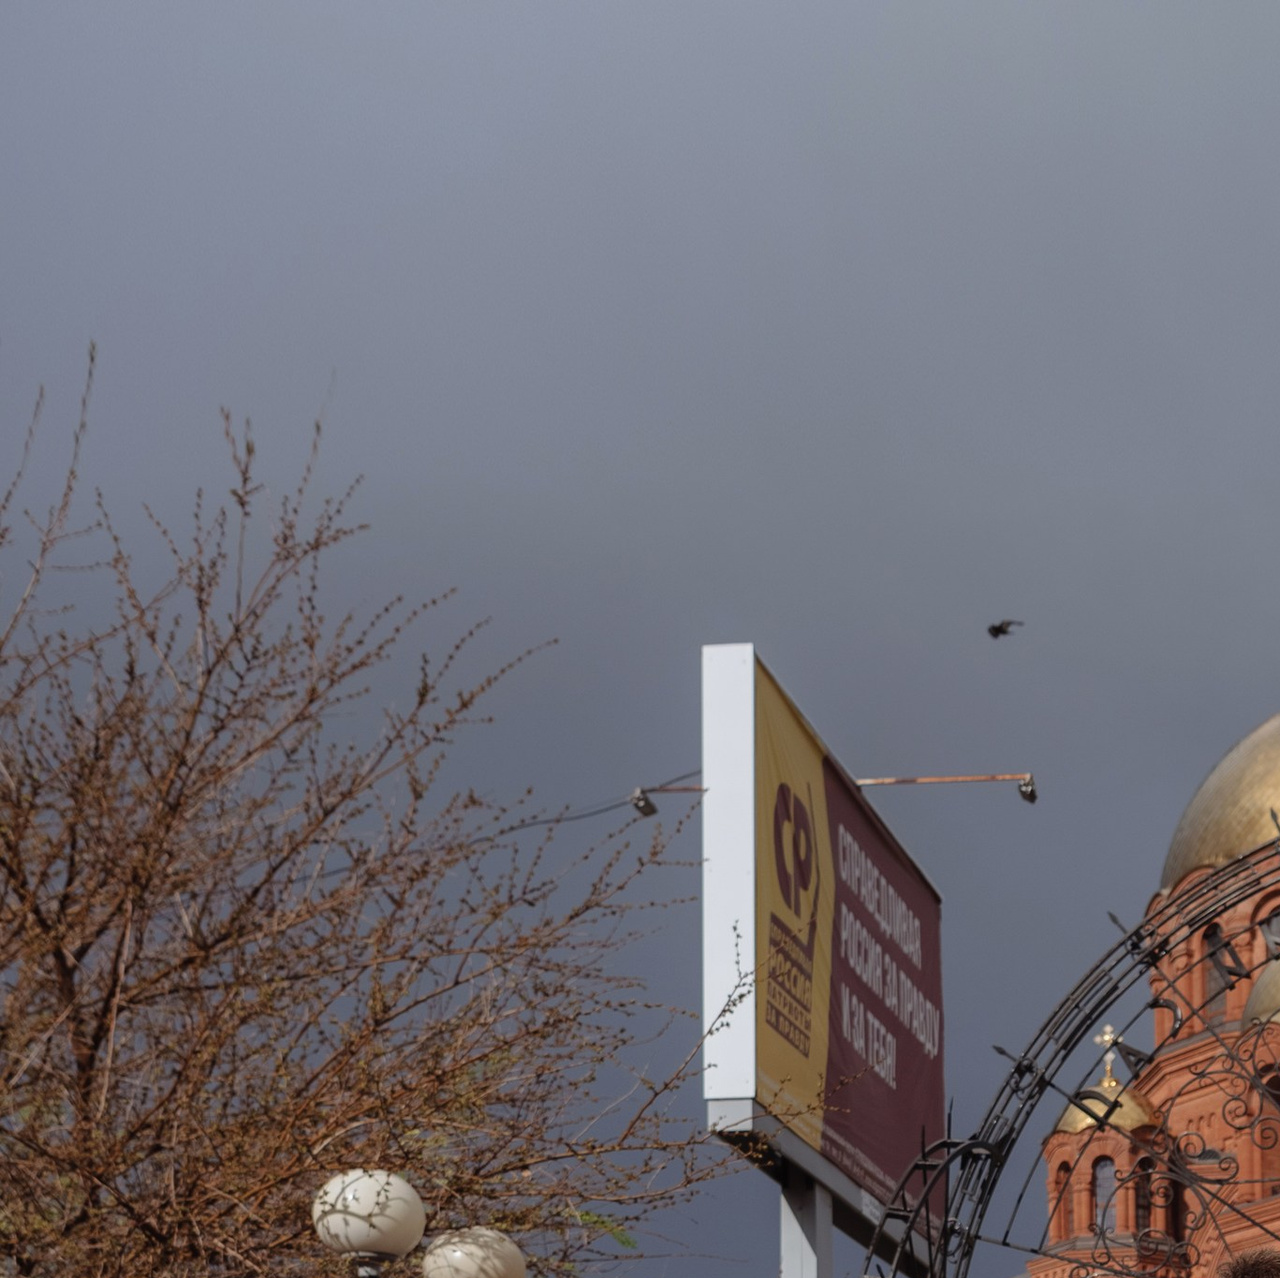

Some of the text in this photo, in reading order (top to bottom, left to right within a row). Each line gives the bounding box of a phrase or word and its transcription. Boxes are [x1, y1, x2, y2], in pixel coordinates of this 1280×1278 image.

[838, 823, 921, 971] СПРАВЕДЛИВАЯ
[840, 902, 940, 1060] РОССИЯ ЗА ПРАВДУ
[841, 983, 851, 1043] И
[852, 995, 866, 1060] ЗА
